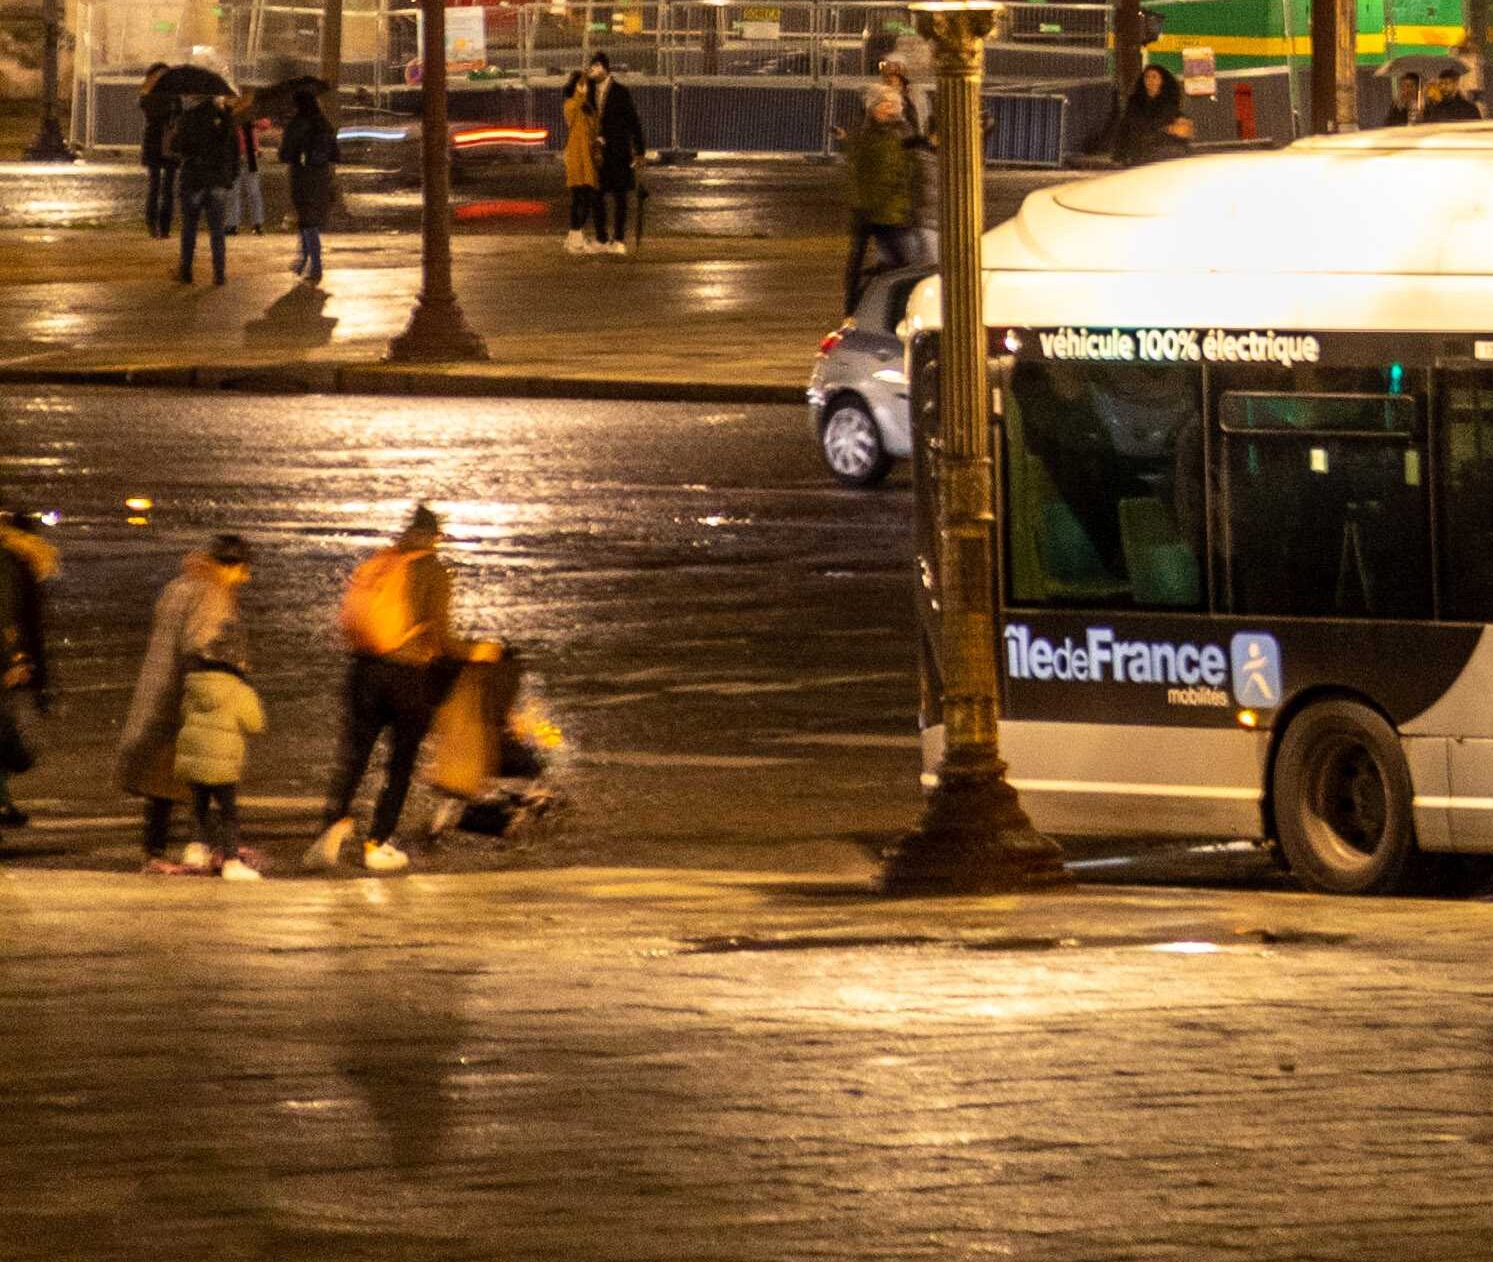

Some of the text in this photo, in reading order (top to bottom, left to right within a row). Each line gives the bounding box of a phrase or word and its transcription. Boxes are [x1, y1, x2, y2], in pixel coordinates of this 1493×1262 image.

[1039, 327, 1321, 368] véhicule 100% électrique
